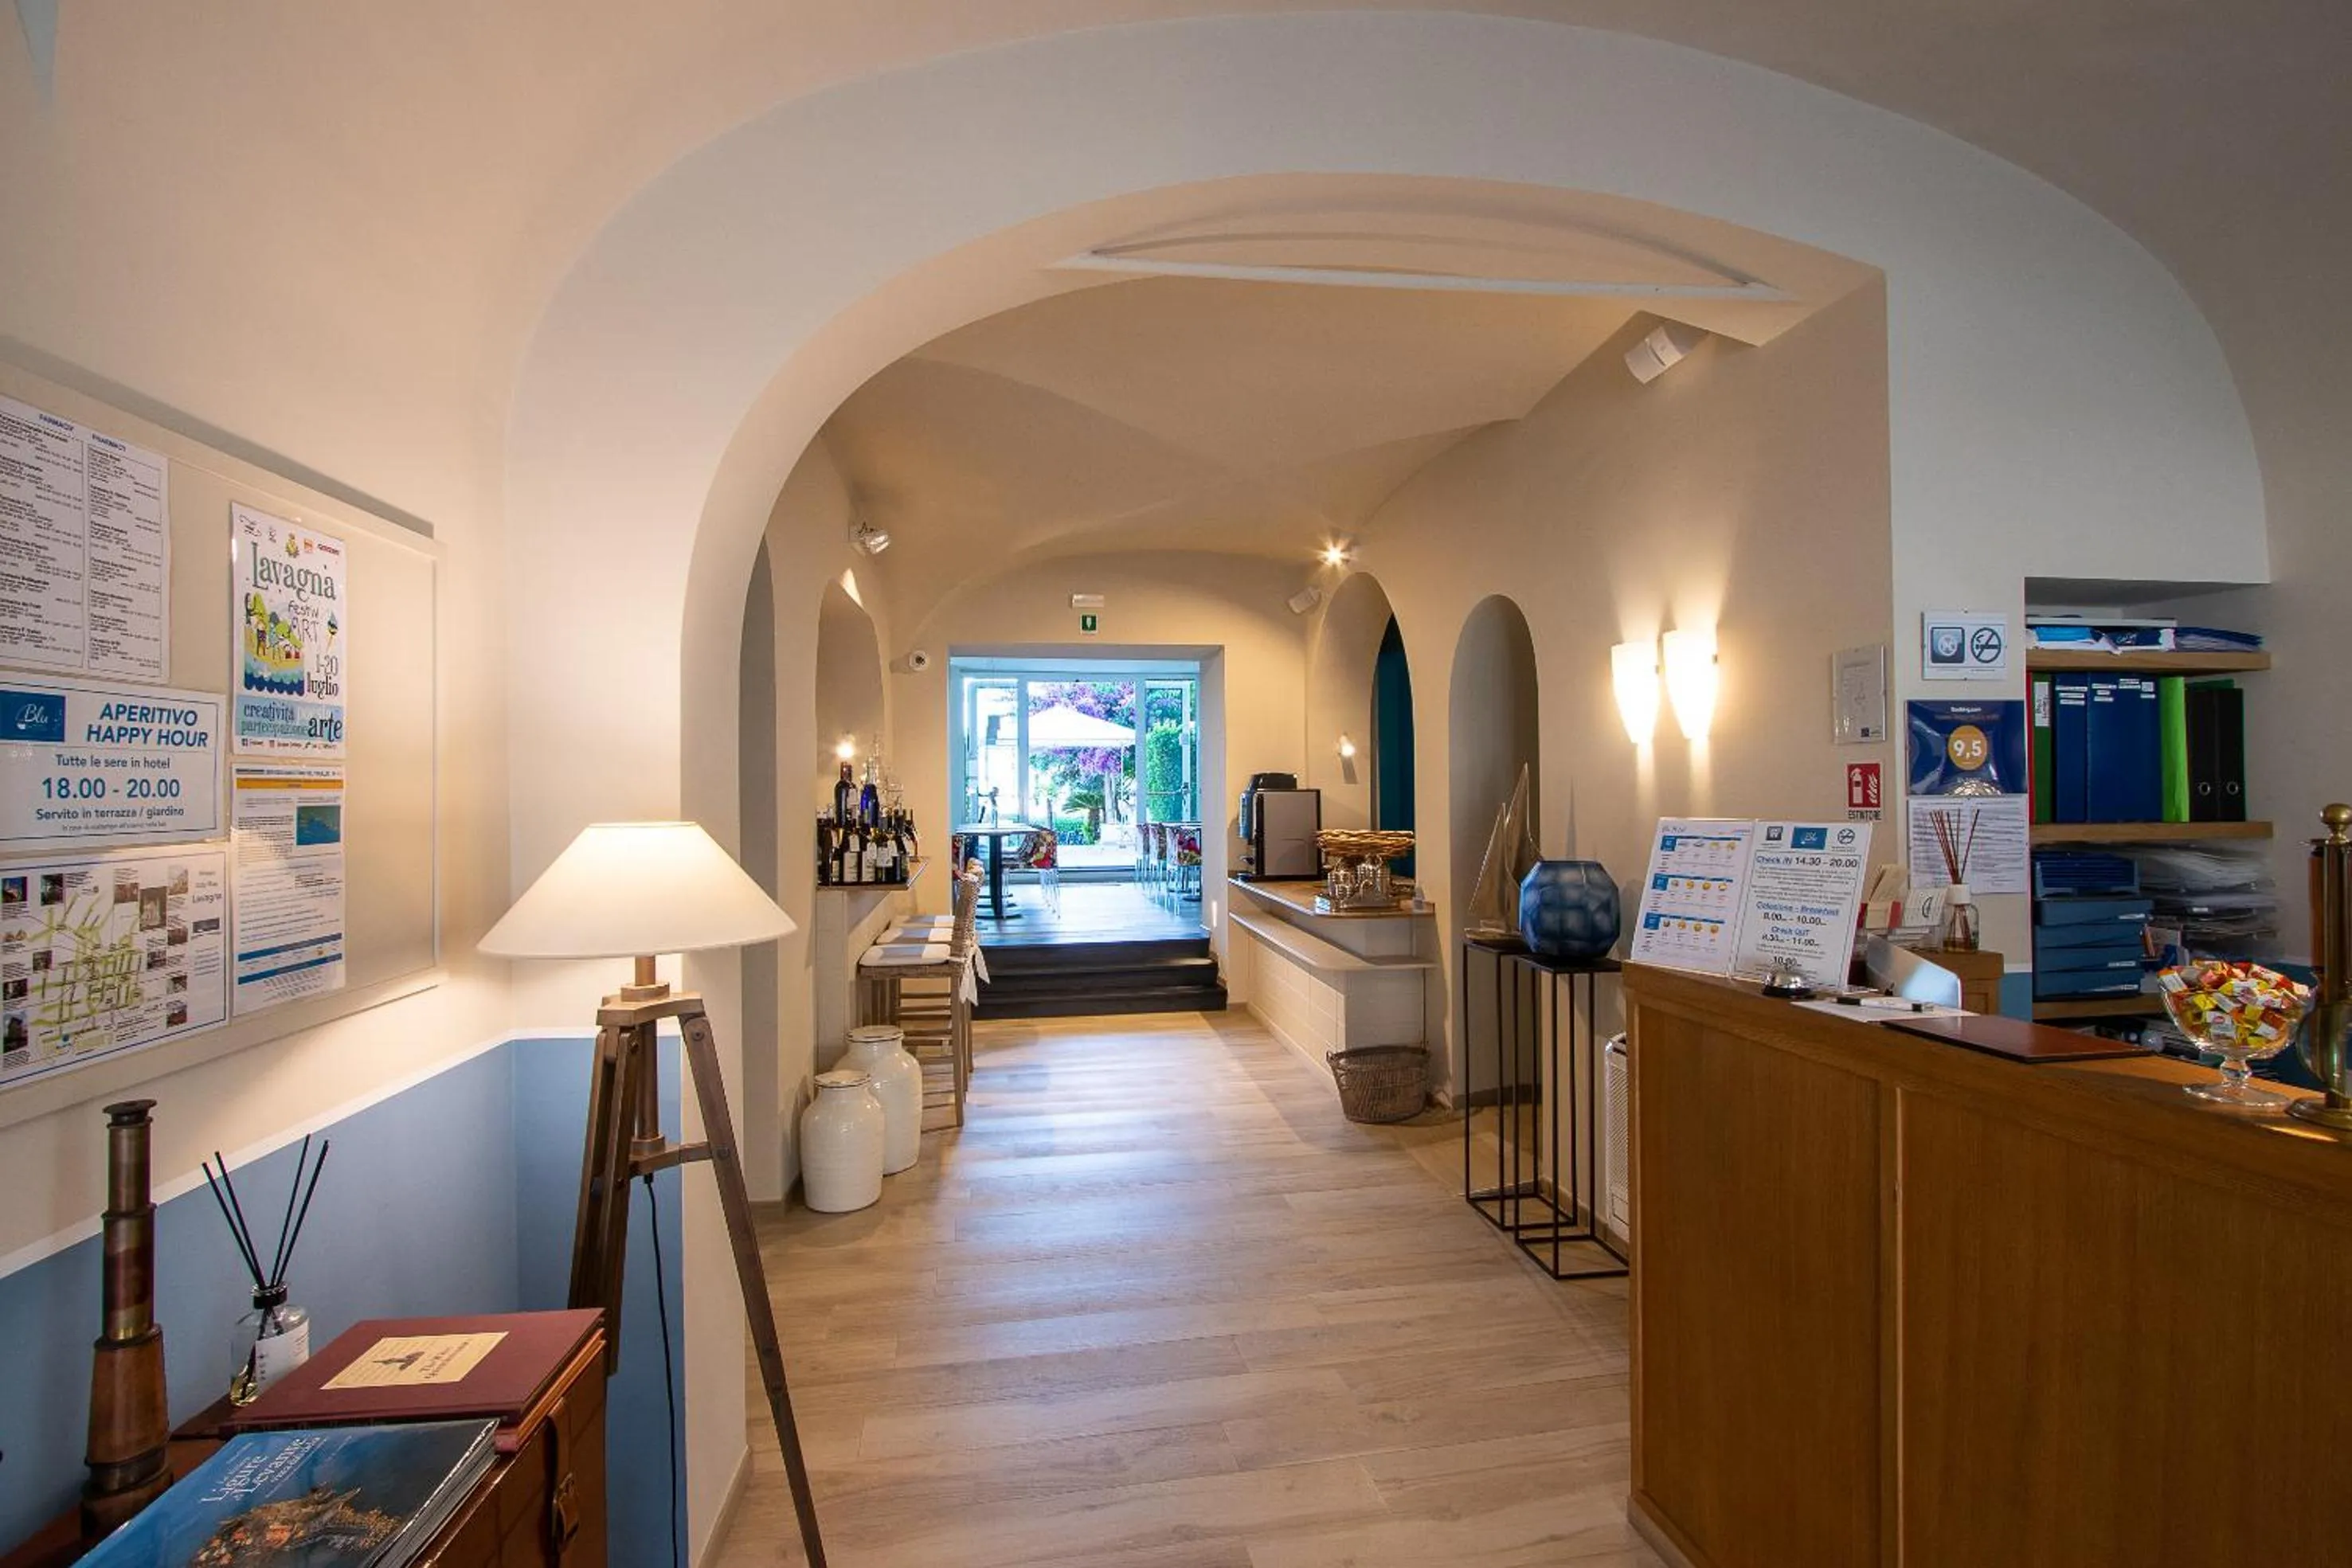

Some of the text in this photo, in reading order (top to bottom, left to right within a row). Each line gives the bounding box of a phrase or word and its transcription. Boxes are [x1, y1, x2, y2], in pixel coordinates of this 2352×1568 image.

[252, 542, 336, 602] Lavagna
[307, 671, 339, 699] luglio
[24, 703, 49, 724] Blu
[100, 702, 198, 726] APERITIVO
[87, 724, 209, 747] HAPPY HOUR
[308, 712, 342, 741] arte
[56, 754, 170, 768] Tutte le sere in hotel
[42, 777, 105, 798] 18.00
[127, 778, 180, 797] 20.00
[36, 808, 78, 820] Servito
[83, 807, 92, 819] in
[95, 807, 137, 818] terrazza
[147, 806, 184, 819] giardino
[1795, 857, 1821, 866] 14.30
[1830, 858, 1857, 867] 20.00
